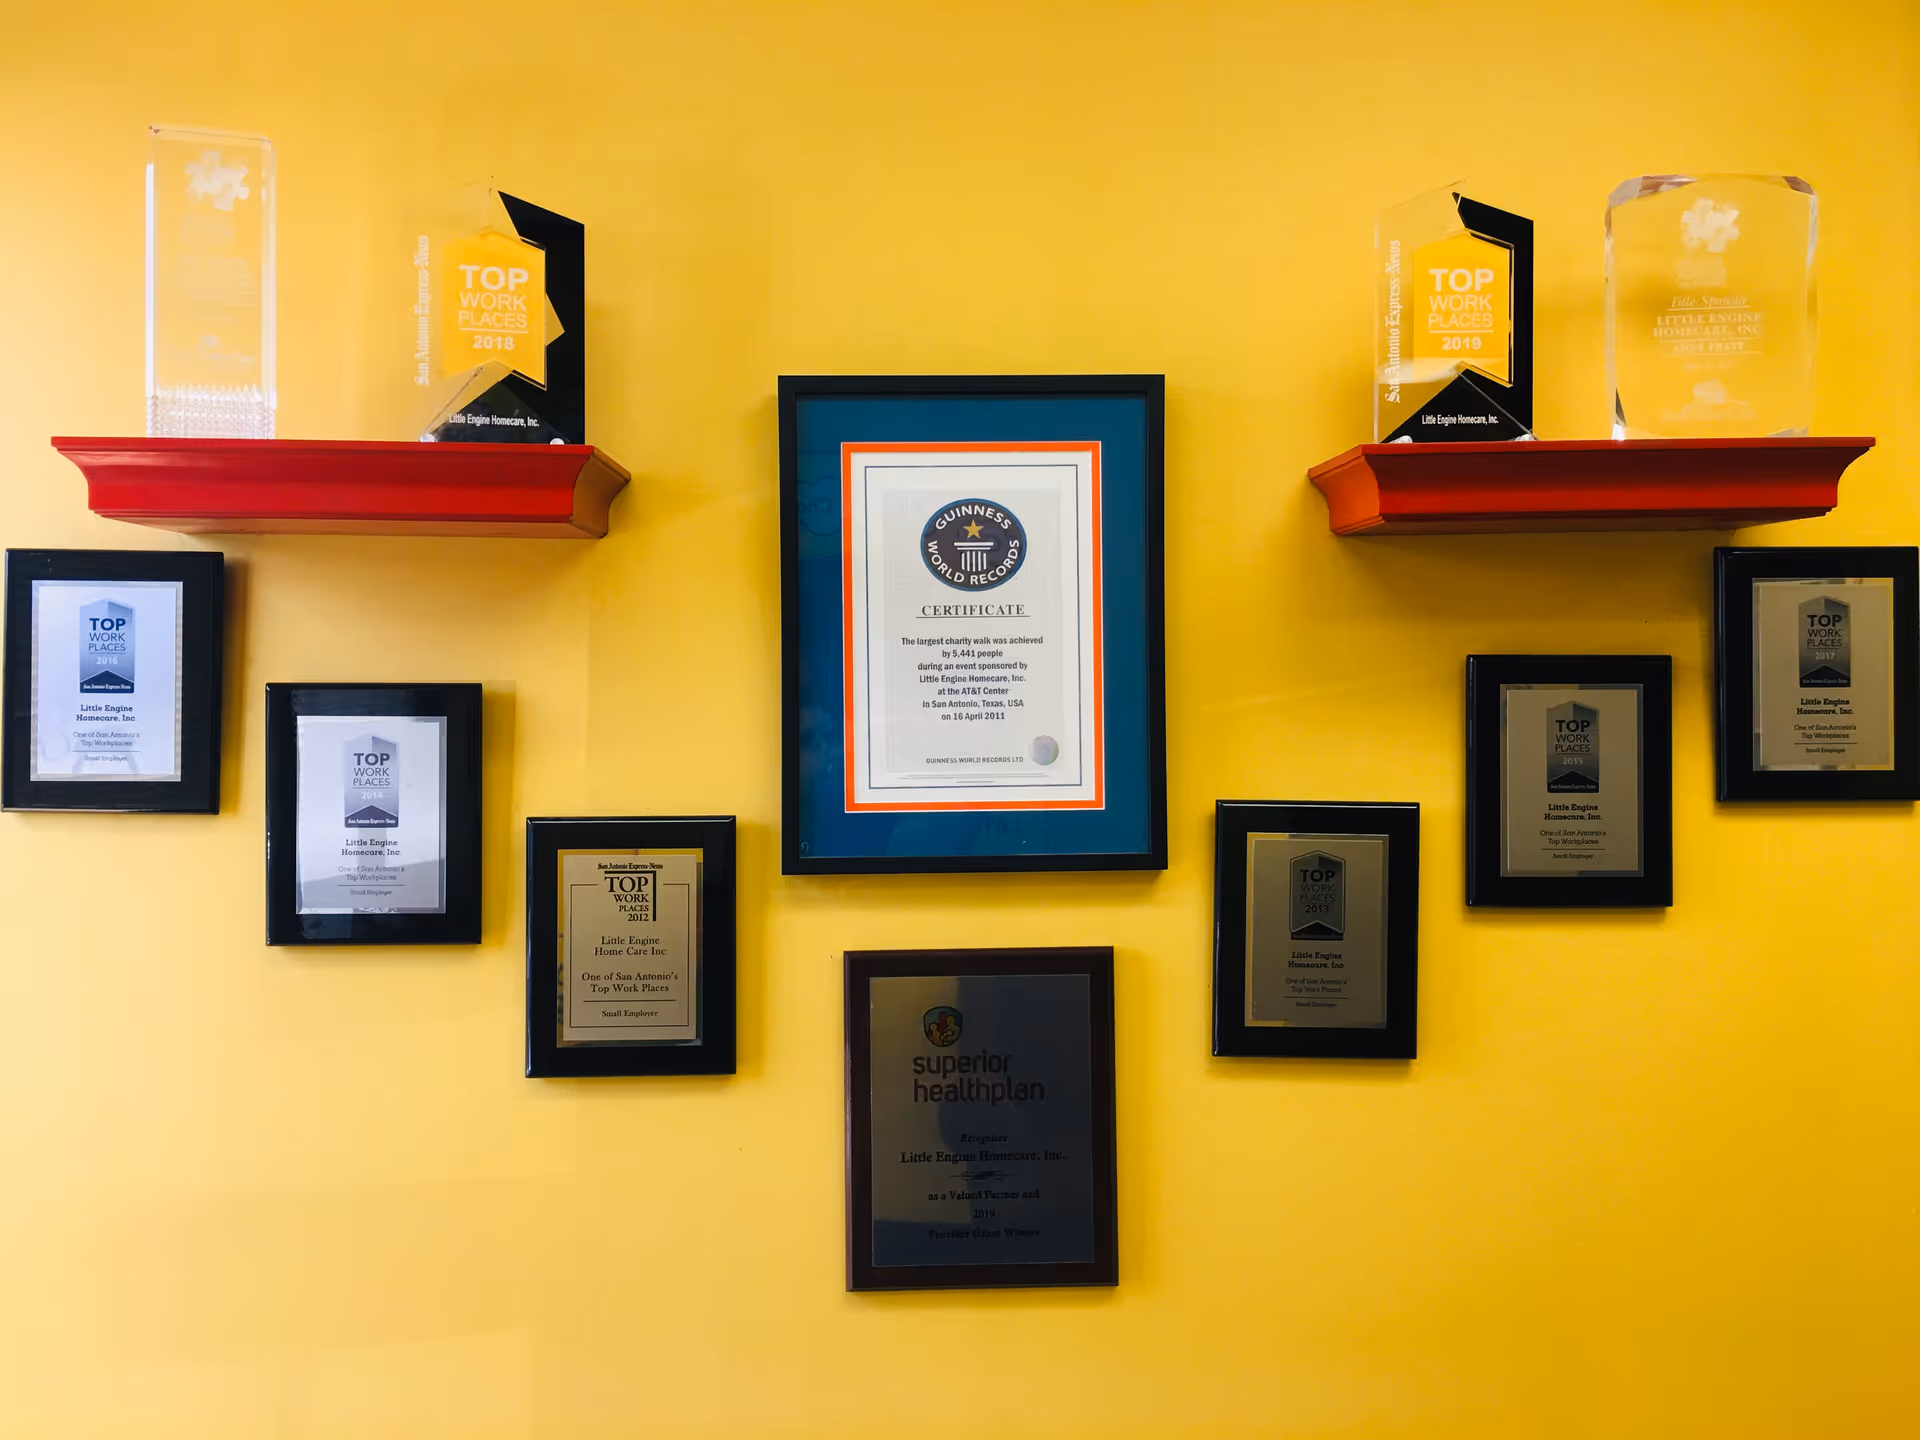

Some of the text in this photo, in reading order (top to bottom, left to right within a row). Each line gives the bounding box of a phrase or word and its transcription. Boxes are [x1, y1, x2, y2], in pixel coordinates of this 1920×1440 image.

[458, 265, 528, 290] TOP
[1429, 269, 1494, 292] TOP
[459, 292, 526, 311] WORK
[1429, 295, 1492, 312] WORK
[458, 310, 528, 328] PLACES
[1428, 313, 1494, 328] PLACES
[473, 335, 514, 350] 2018
[1442, 337, 1482, 350] 2019
[1385, 328, 1400, 378] Antonio
[1385, 379, 1400, 403] San
[449, 414, 540, 428] Little Engine Homecare, Inc.
[1422, 414, 1499, 426] Little Engine Homecare, Inc.
[935, 504, 1012, 530] GUINNESS
[928, 539, 1020, 585] WORLD RECORDS
[922, 604, 1025, 616] CERTIFICATE
[89, 618, 126, 631] TOP
[1807, 614, 1842, 628] TOP
[89, 632, 125, 642] WORK
[1807, 628, 1842, 638] WORK
[901, 637, 915, 646] The
[917, 637, 944, 647] largest
[945, 636, 972, 647] charity
[973, 636, 991, 645] walk
[1009, 636, 1043, 645] achieved
[1807, 638, 1842, 647] PLACES
[88, 643, 126, 652] PLACES
[942, 649, 1003, 659] by 5,441 people
[1815, 652, 1835, 660] 2017
[96, 656, 118, 665] 2016
[918, 662, 942, 672] during
[978, 662, 1017, 671] sponsored
[1019, 662, 1028, 671] by
[919, 674, 1026, 684] Little Engine Homecare, Inc.
[947, 687, 960, 695] the
[961, 687, 981, 695] AT&T
[983, 687, 1009, 695] Center
[922, 699, 1024, 709] in San Antonio, Texas, USA
[1823, 698, 1850, 707] Engine
[80, 704, 133, 713] Little Engine
[965, 712, 983, 722] April
[984, 712, 1005, 720] 2011
[1555, 720, 1590, 732] TOP
[1555, 734, 1590, 743] WORK
[81, 740, 93, 748] Top
[1555, 744, 1591, 752] PLACES
[354, 753, 390, 766] TOP
[1563, 757, 1583, 765] 2015
[353, 767, 390, 777] WORK
[353, 778, 391, 787] PLACES
[1571, 804, 1598, 812] Engine
[369, 839, 398, 848] Engine
[341, 848, 385, 857] Homecare,
[628, 862, 664, 870] Express-News
[1300, 869, 1336, 882] TOP
[604, 876, 649, 893] TOP
[1300, 884, 1335, 893] WORK
[613, 894, 649, 903] WORK
[1305, 905, 1329, 913] 2013
[627, 913, 649, 922] 2012
[601, 936, 660, 946] Little Engine
[594, 947, 623, 956] Home
[626, 947, 648, 956] Care
[581, 972, 678, 981] One of San Antonio's
[590, 984, 669, 994] Top Work Places
[624, 1010, 658, 1018] Employer
[912, 1050, 1013, 1079] superior
[913, 1076, 1045, 1106] healthplan
[900, 1151, 932, 1163] Little
[936, 1151, 976, 1164] Engine
[928, 1193, 938, 1201] as
[949, 1190, 982, 1200] Valued
[1022, 1189, 1040, 1199] and
